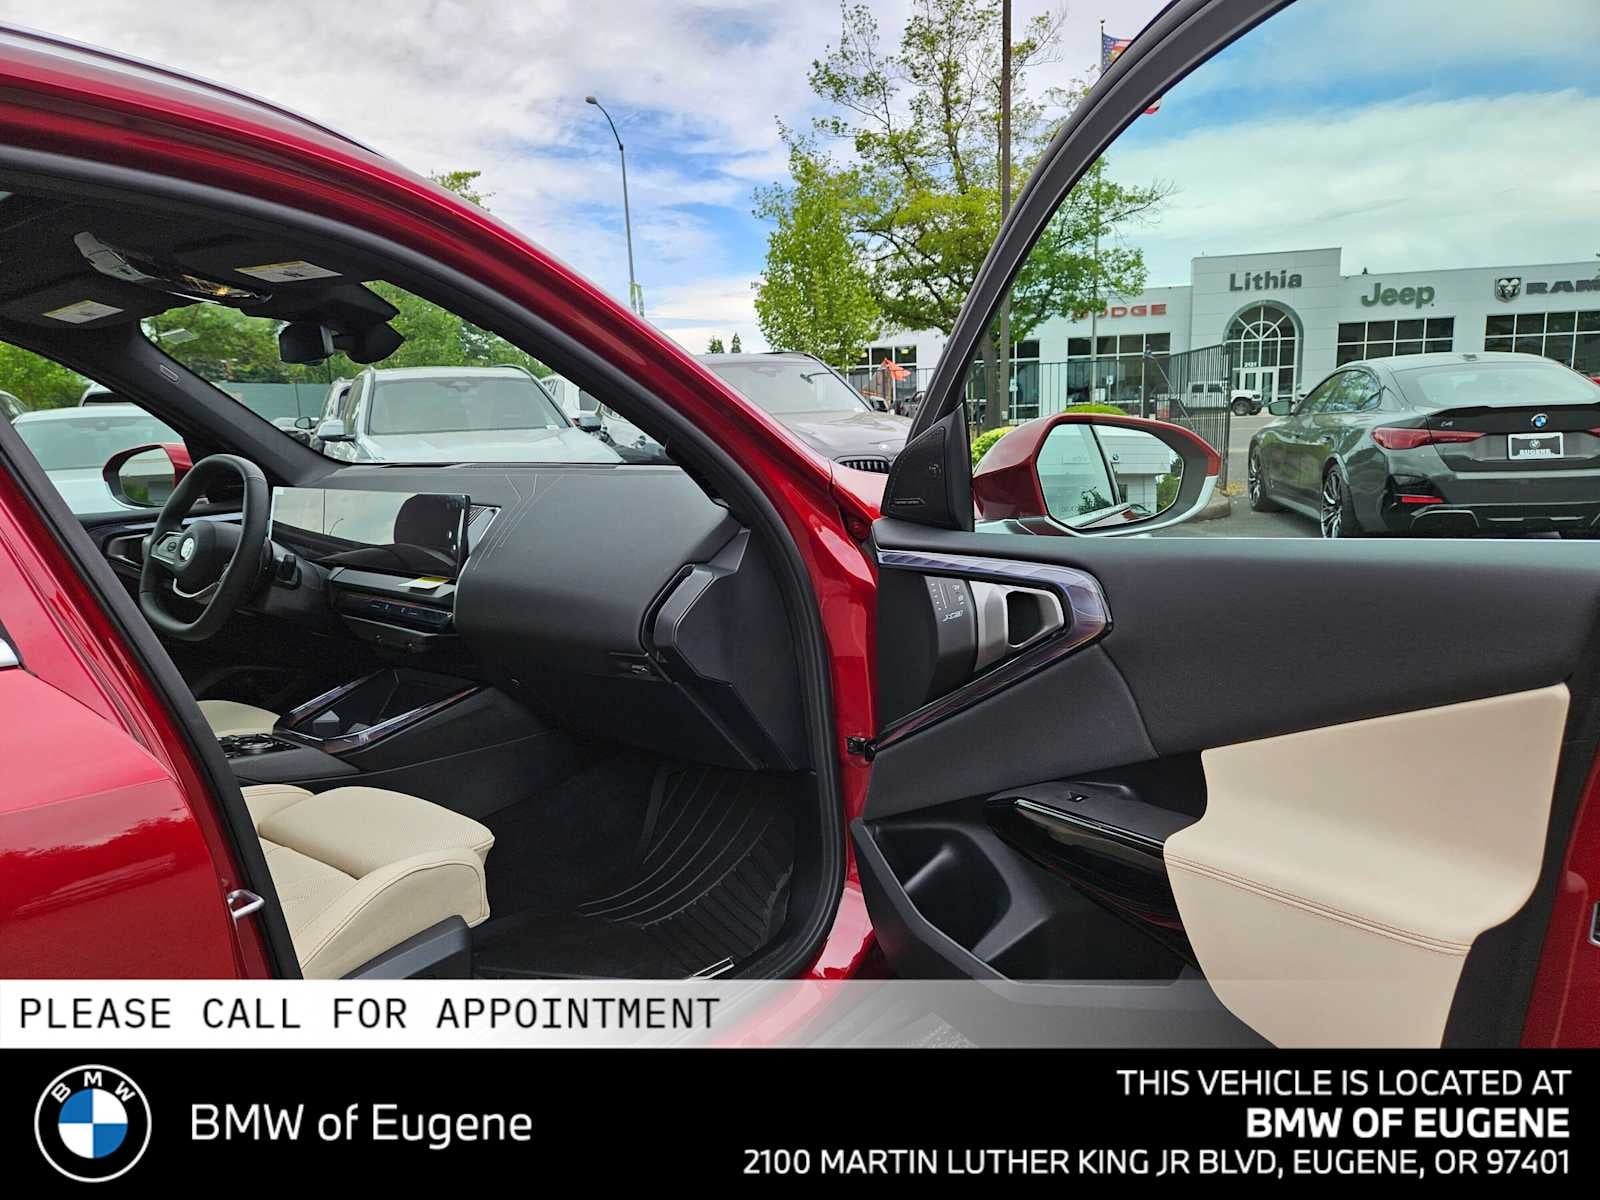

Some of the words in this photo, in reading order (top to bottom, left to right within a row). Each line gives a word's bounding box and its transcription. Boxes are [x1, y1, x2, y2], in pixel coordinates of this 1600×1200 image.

[1229, 270, 1303, 292] Lithia
[1526, 279, 1600, 295] RAM
[1361, 282, 1435, 309] Jeep
